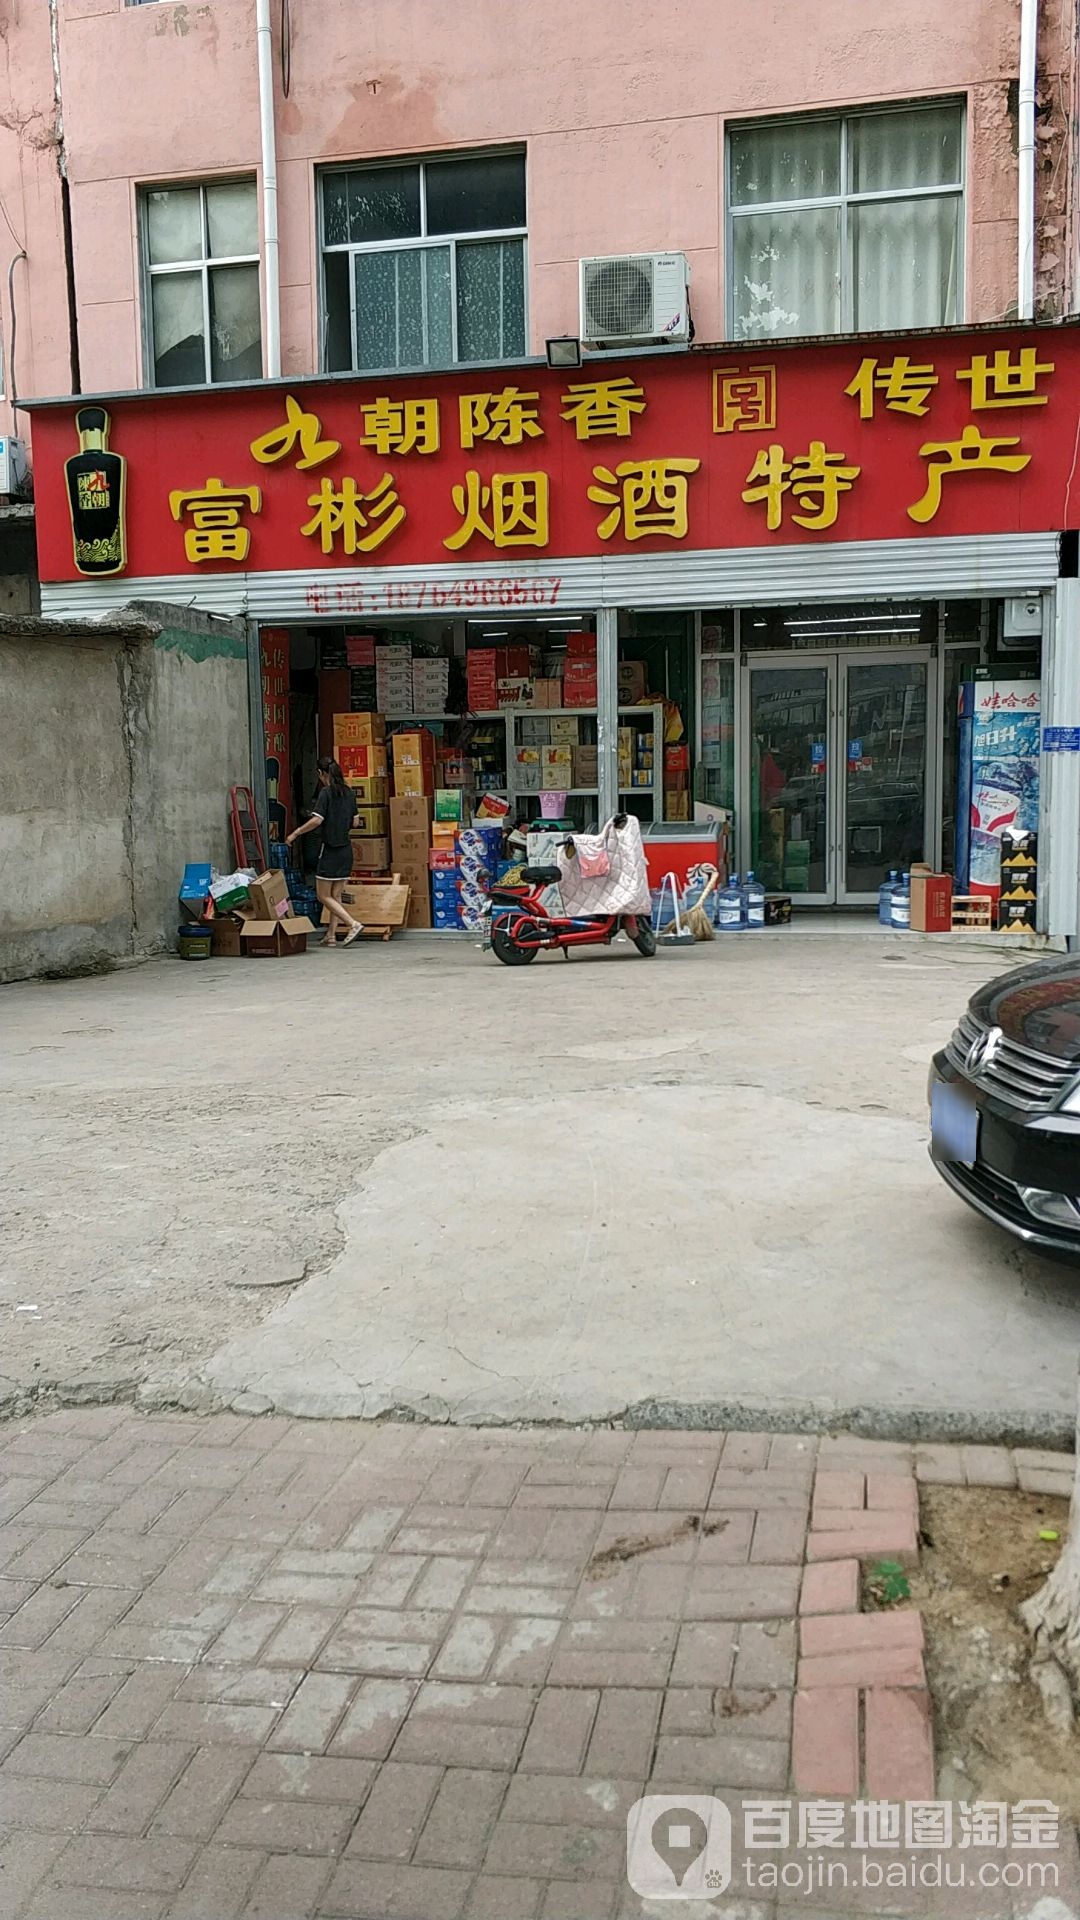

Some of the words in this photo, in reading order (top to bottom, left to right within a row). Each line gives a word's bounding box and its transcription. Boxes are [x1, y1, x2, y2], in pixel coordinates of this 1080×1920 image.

[249, 375, 647, 470] 九朝陈香
[844, 347, 1056, 421] 传世
[168, 423, 1032, 564] 富彬烟酒特产
[981, 692, 1040, 709] 娃哈哈
